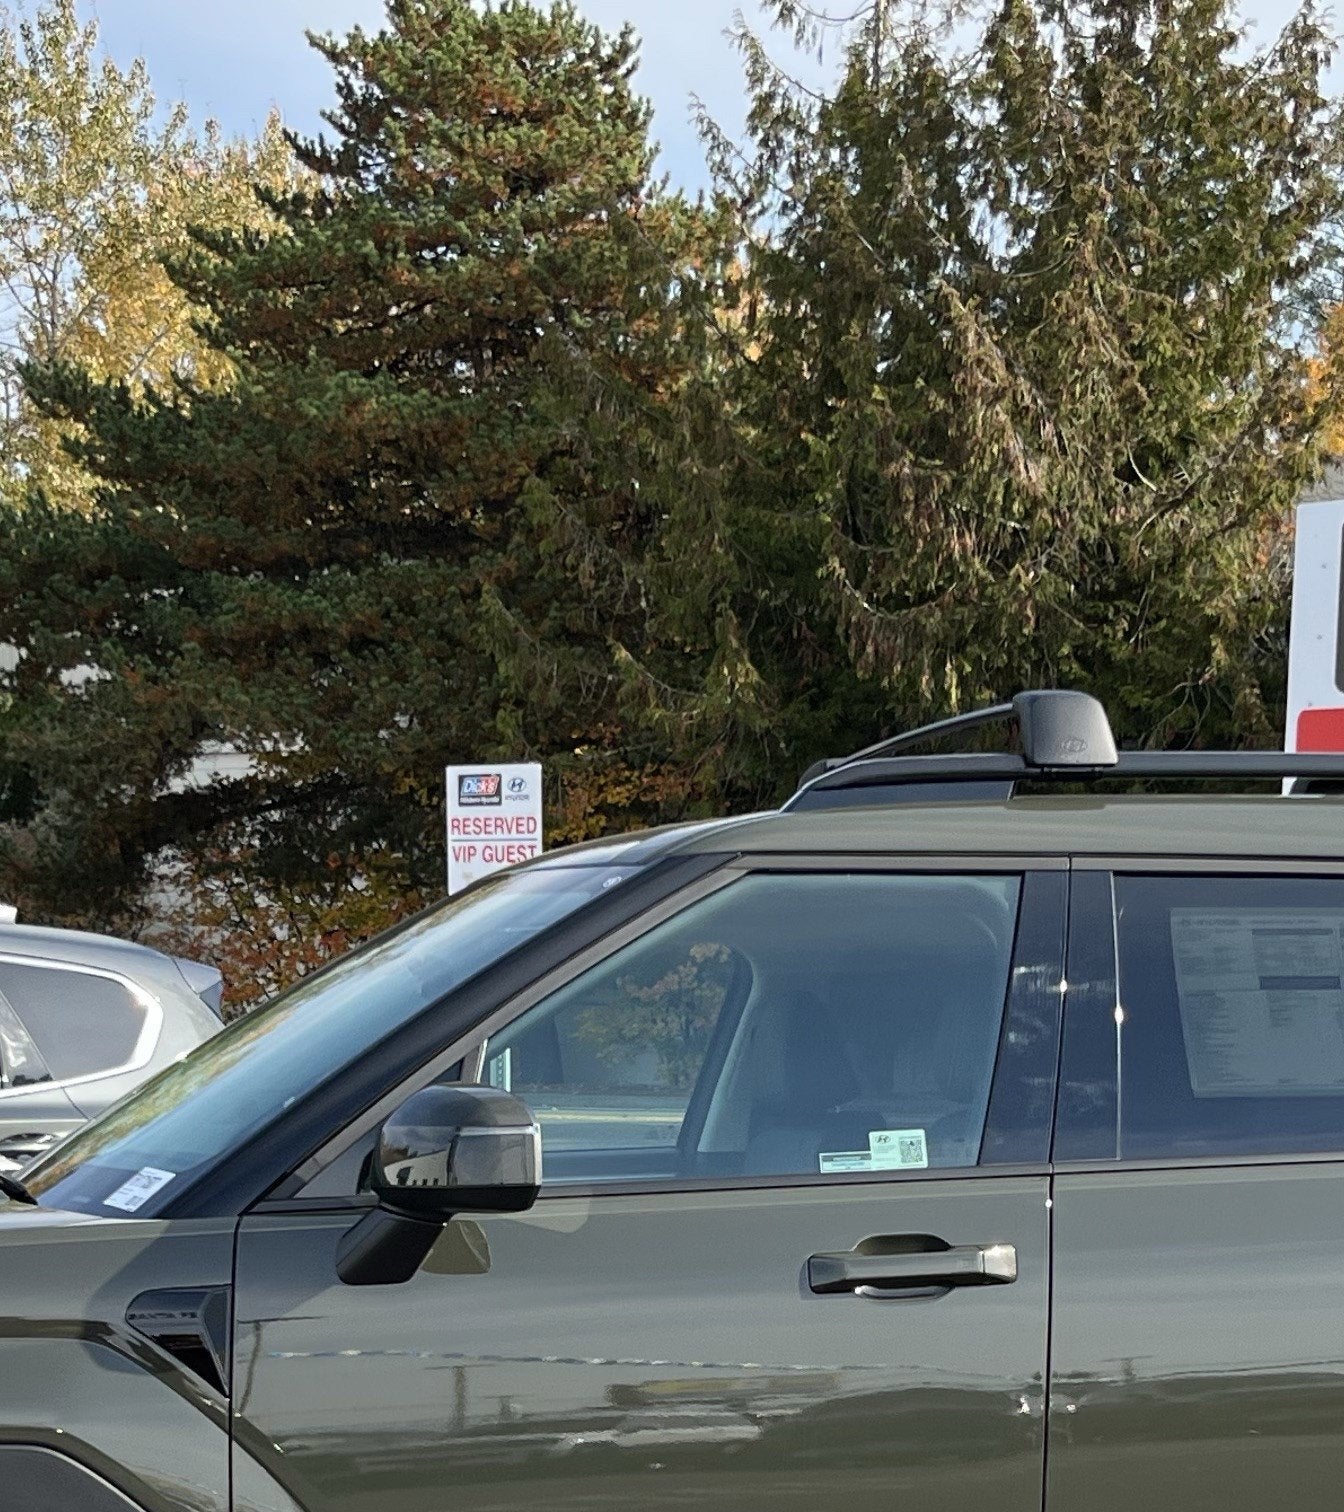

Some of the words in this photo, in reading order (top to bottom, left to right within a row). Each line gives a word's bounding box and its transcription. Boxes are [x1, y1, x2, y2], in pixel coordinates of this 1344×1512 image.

[451, 816, 537, 835] RESERVED
[452, 845, 477, 863] VIP
[482, 845, 537, 864] GUEST
